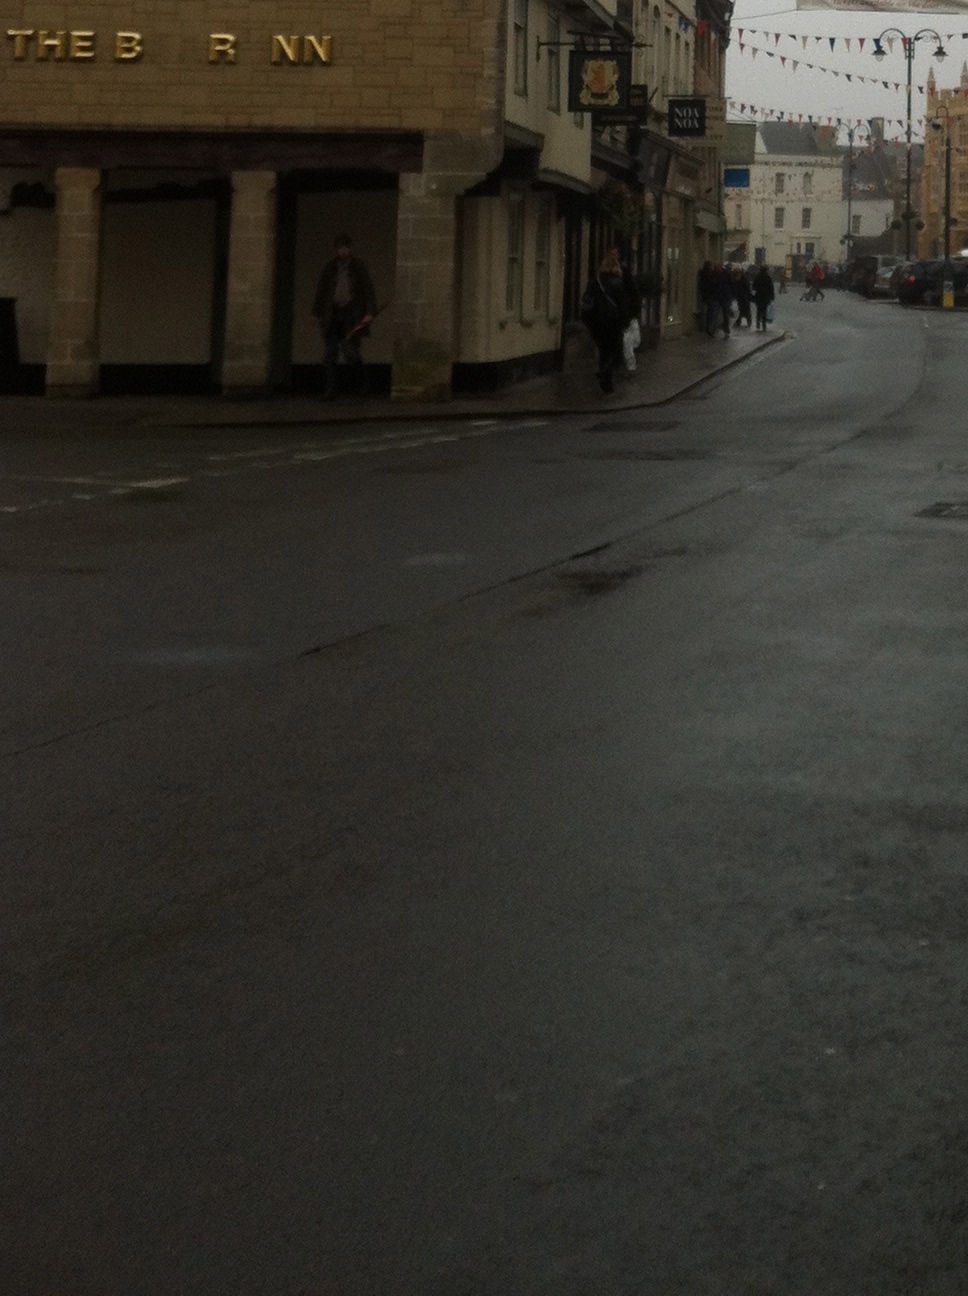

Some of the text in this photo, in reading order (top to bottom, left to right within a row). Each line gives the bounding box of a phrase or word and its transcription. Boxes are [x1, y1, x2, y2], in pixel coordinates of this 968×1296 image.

[7, 29, 95, 61] THE
[674, 107, 699, 118] NOA
[674, 118, 699, 129] NOA
